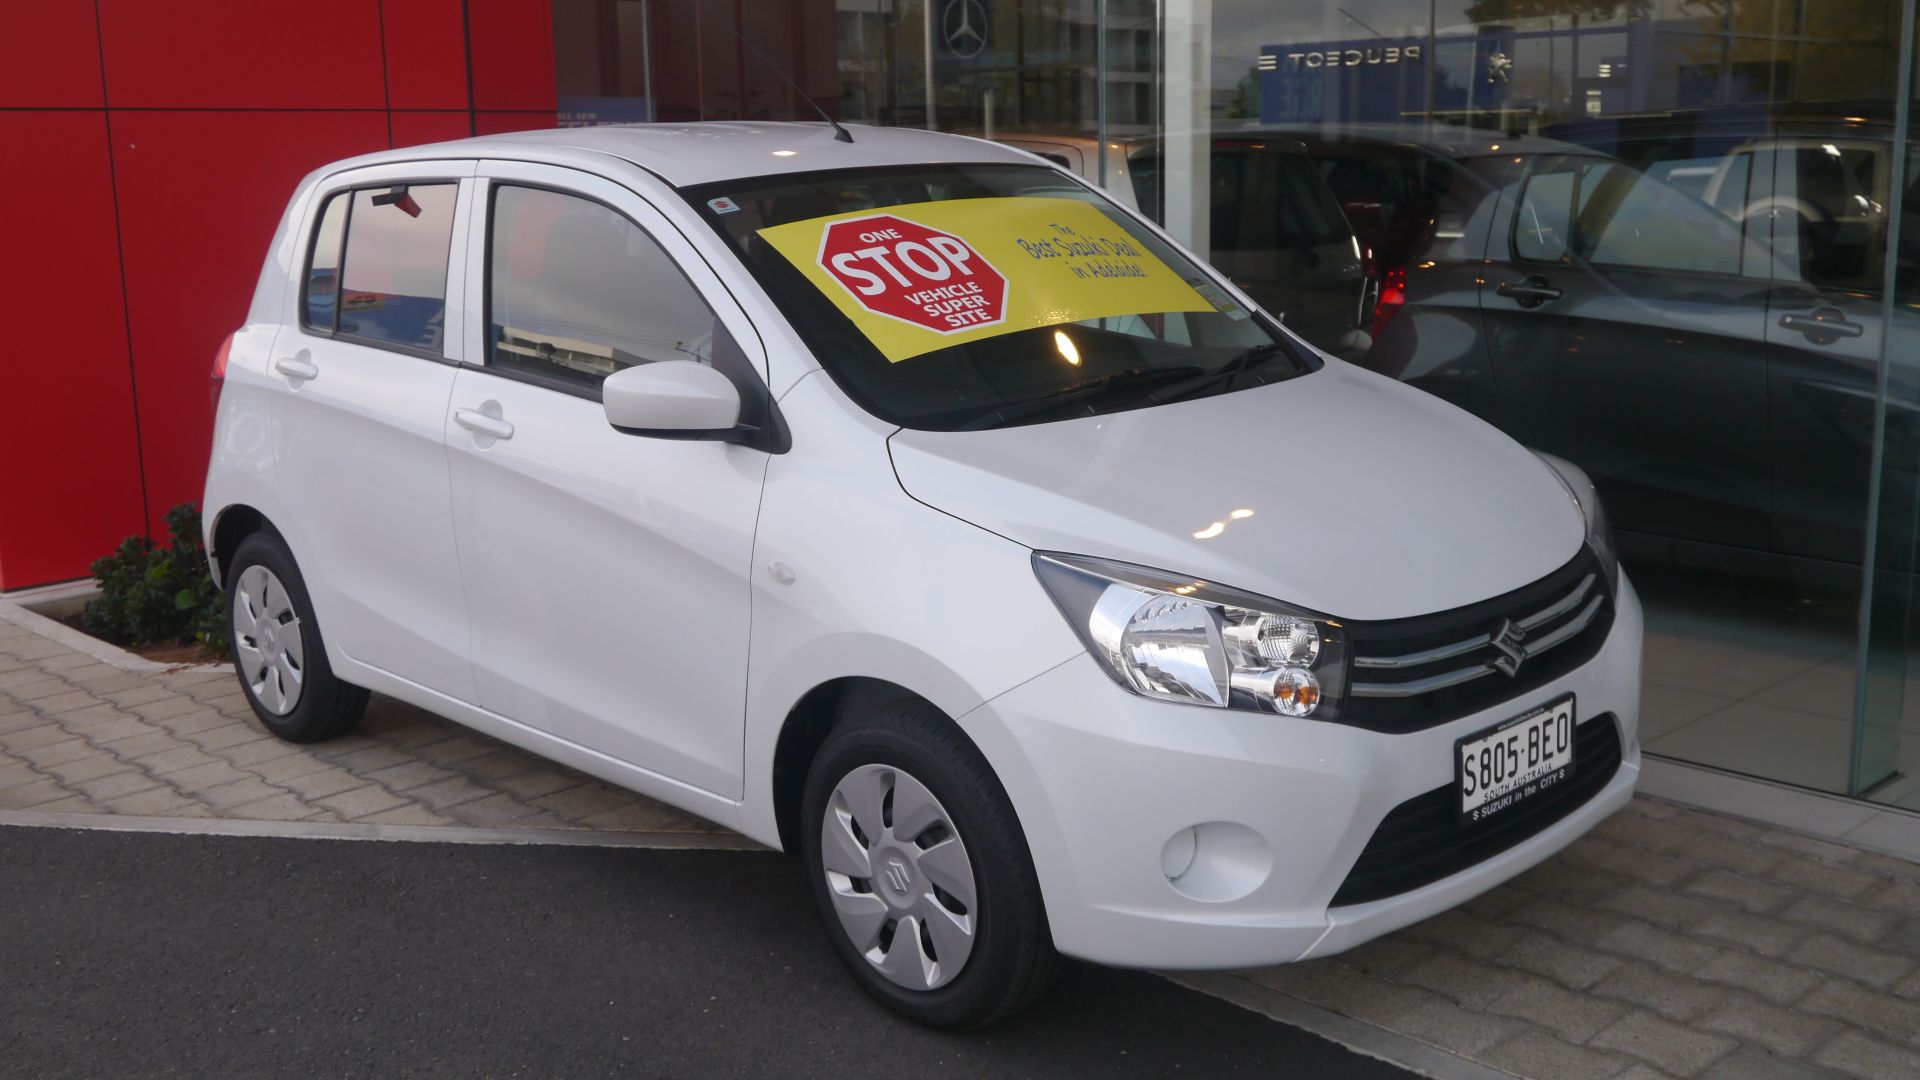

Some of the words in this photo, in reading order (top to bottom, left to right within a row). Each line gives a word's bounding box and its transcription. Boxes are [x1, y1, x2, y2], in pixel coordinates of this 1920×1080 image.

[859, 228, 903, 244] ONE
[1048, 223, 1076, 236] The
[1016, 238, 1062, 259] Best
[1052, 234, 1110, 257] Suzuki
[1098, 236, 1142, 257] Deal
[831, 236, 974, 296] STOP
[1064, 260, 1091, 279] in
[904, 281, 983, 306] VEHICLE
[923, 295, 992, 317] SUPER
[944, 308, 993, 328] SITE
[1484, 783, 1510, 803] SOUTH
[1513, 762, 1553, 790] AUSTRALIA
[1481, 795, 1512, 818] SUZUKI
[1514, 791, 1523, 802] in
[1524, 784, 1537, 797] the
[1540, 773, 1558, 789] CITY
